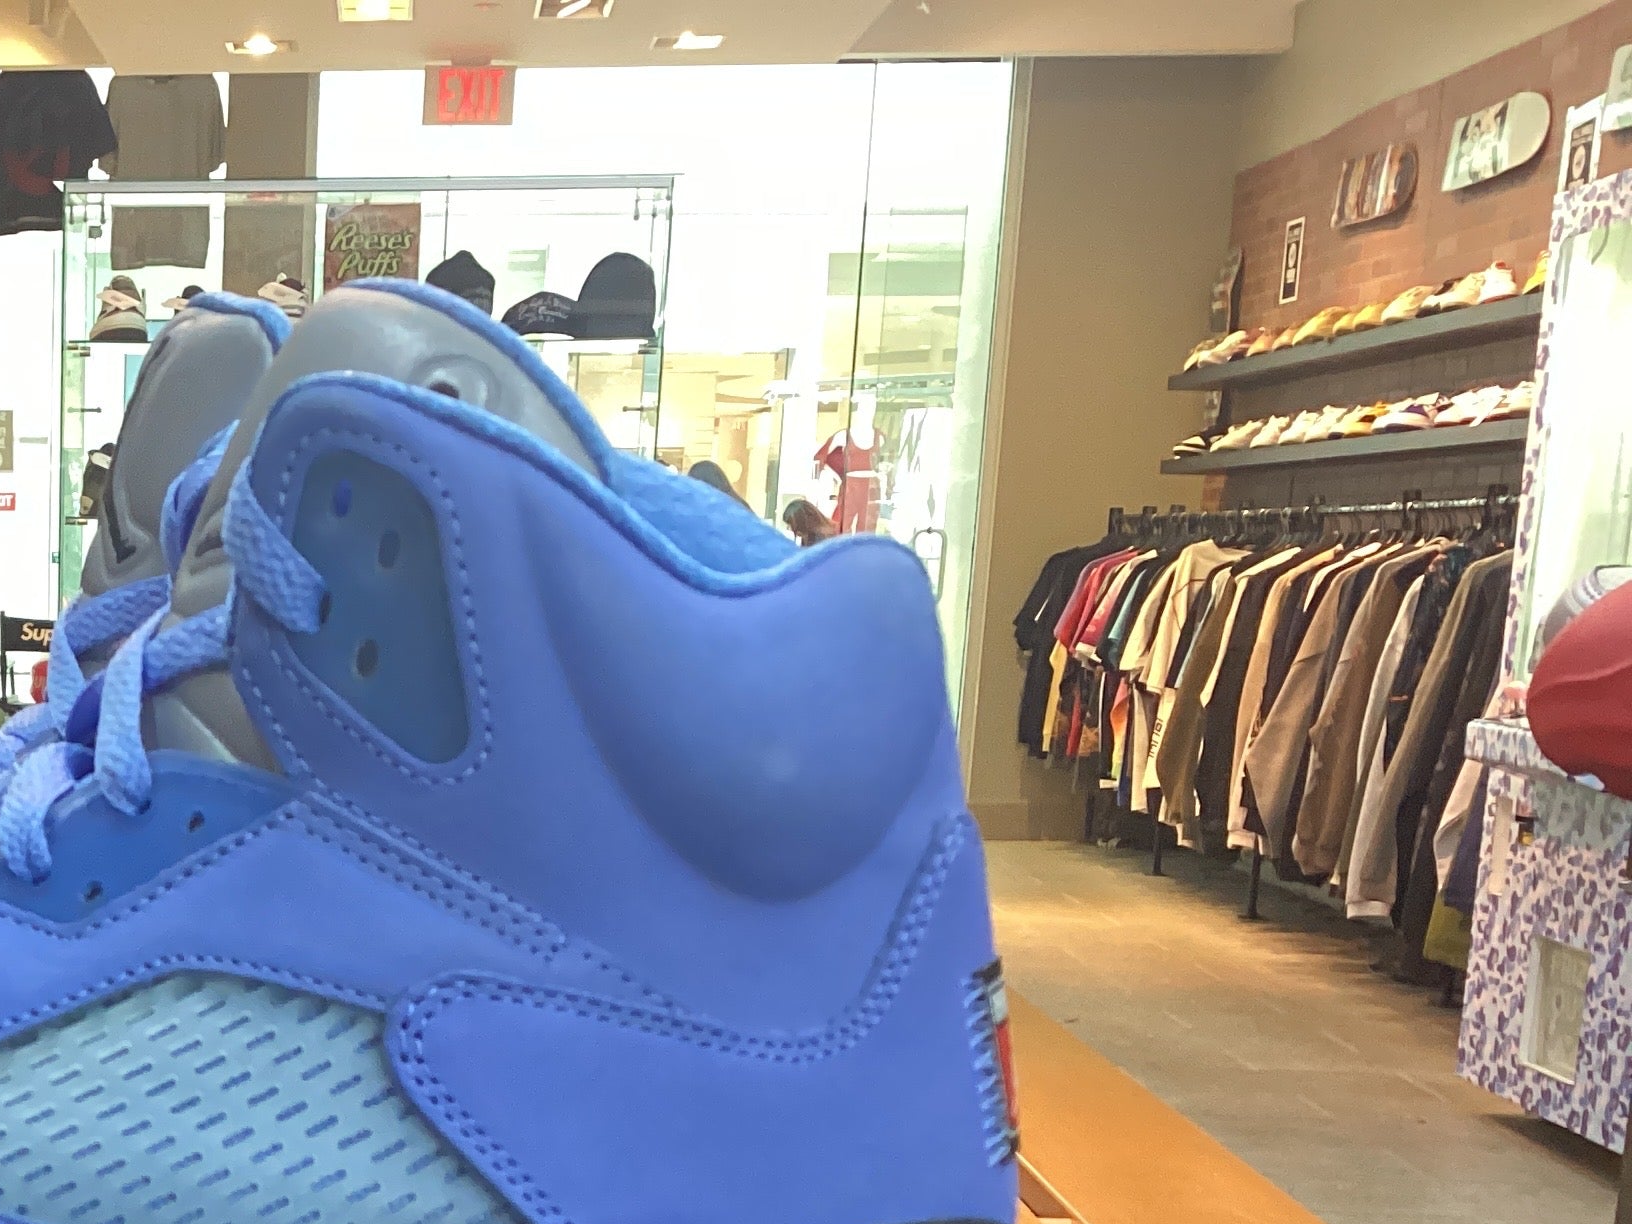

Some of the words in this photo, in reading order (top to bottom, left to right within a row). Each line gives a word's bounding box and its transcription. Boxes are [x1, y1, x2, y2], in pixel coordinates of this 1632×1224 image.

[438, 67, 506, 122] EXIT
[329, 222, 414, 252] Reese's
[337, 250, 402, 279] Puffs
